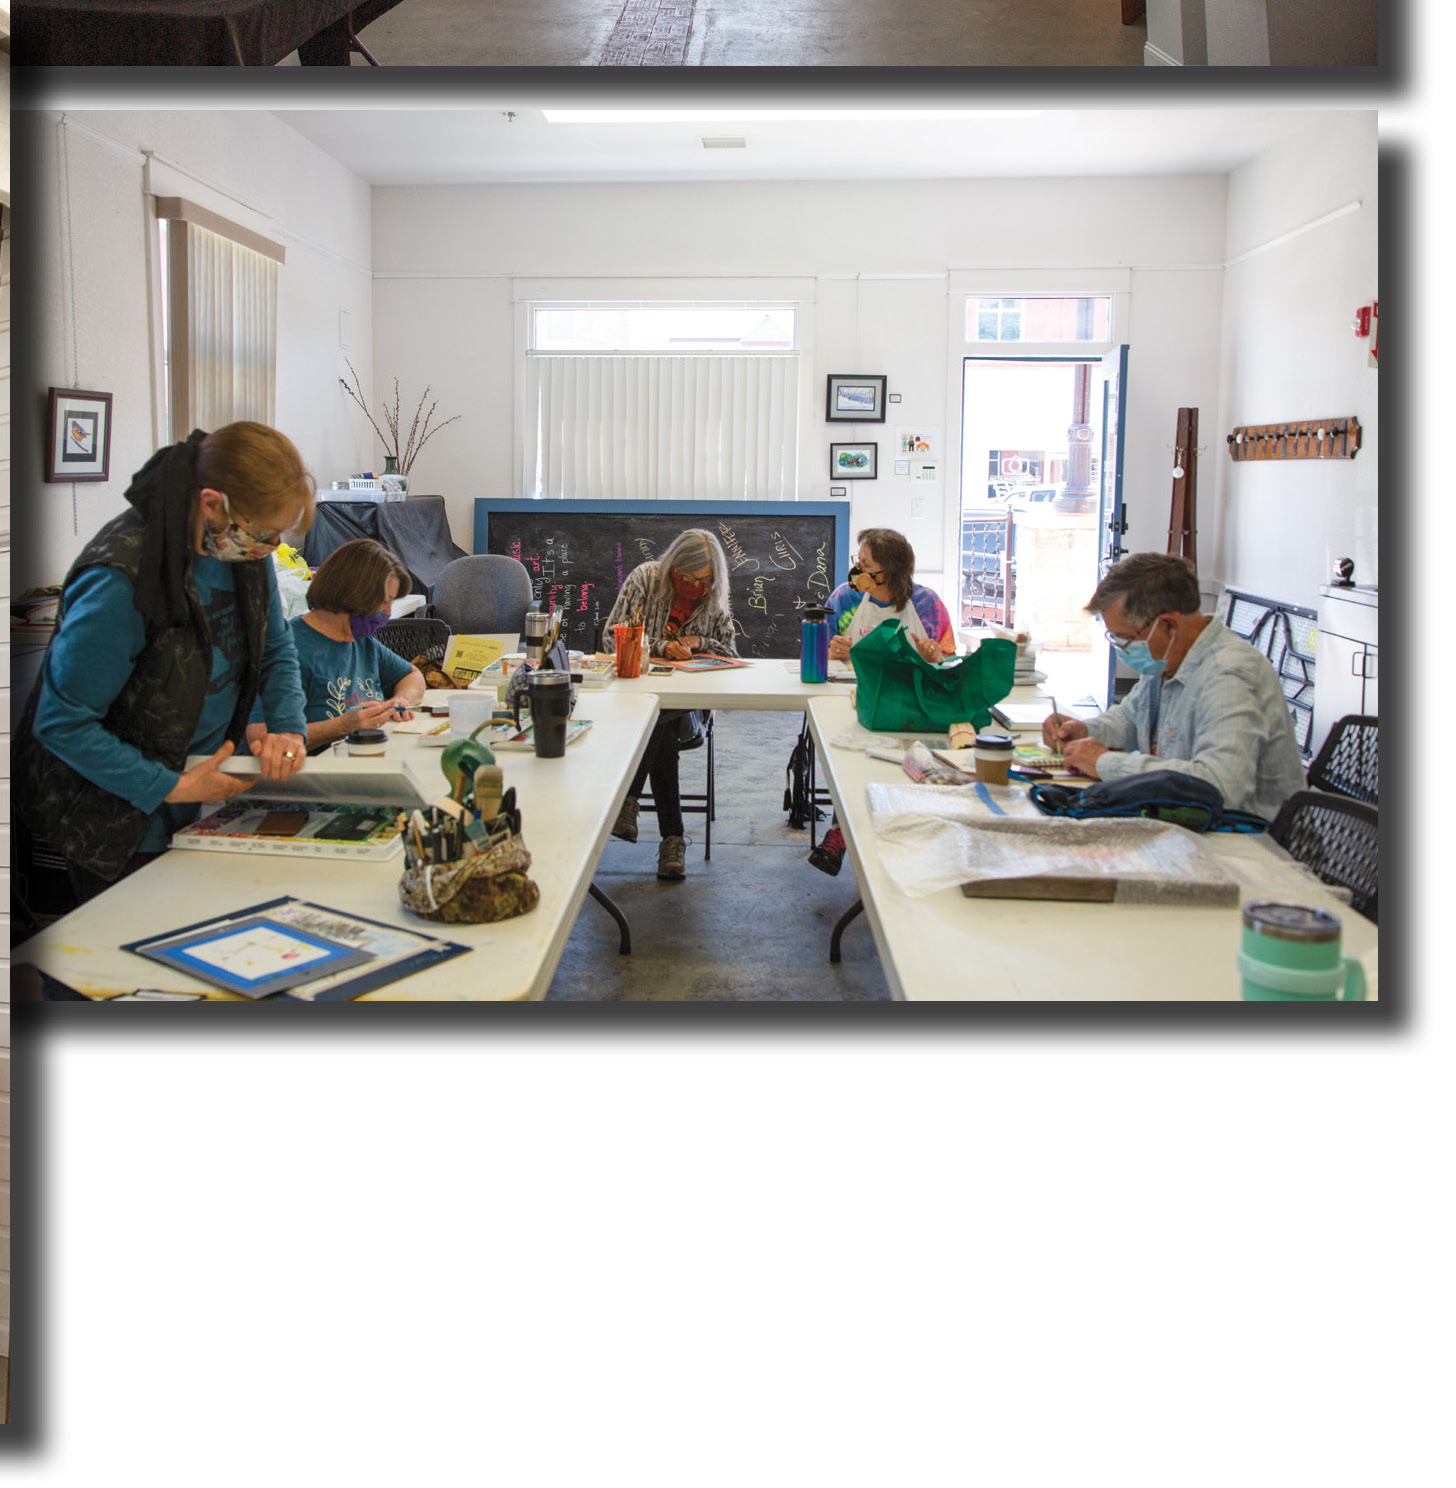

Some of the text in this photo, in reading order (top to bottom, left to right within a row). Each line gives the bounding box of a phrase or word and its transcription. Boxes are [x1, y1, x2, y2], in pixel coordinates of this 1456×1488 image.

[769, 531, 797, 570] CHRIS
[806, 541, 831, 593] Dana
[747, 575, 776, 615] Brian
